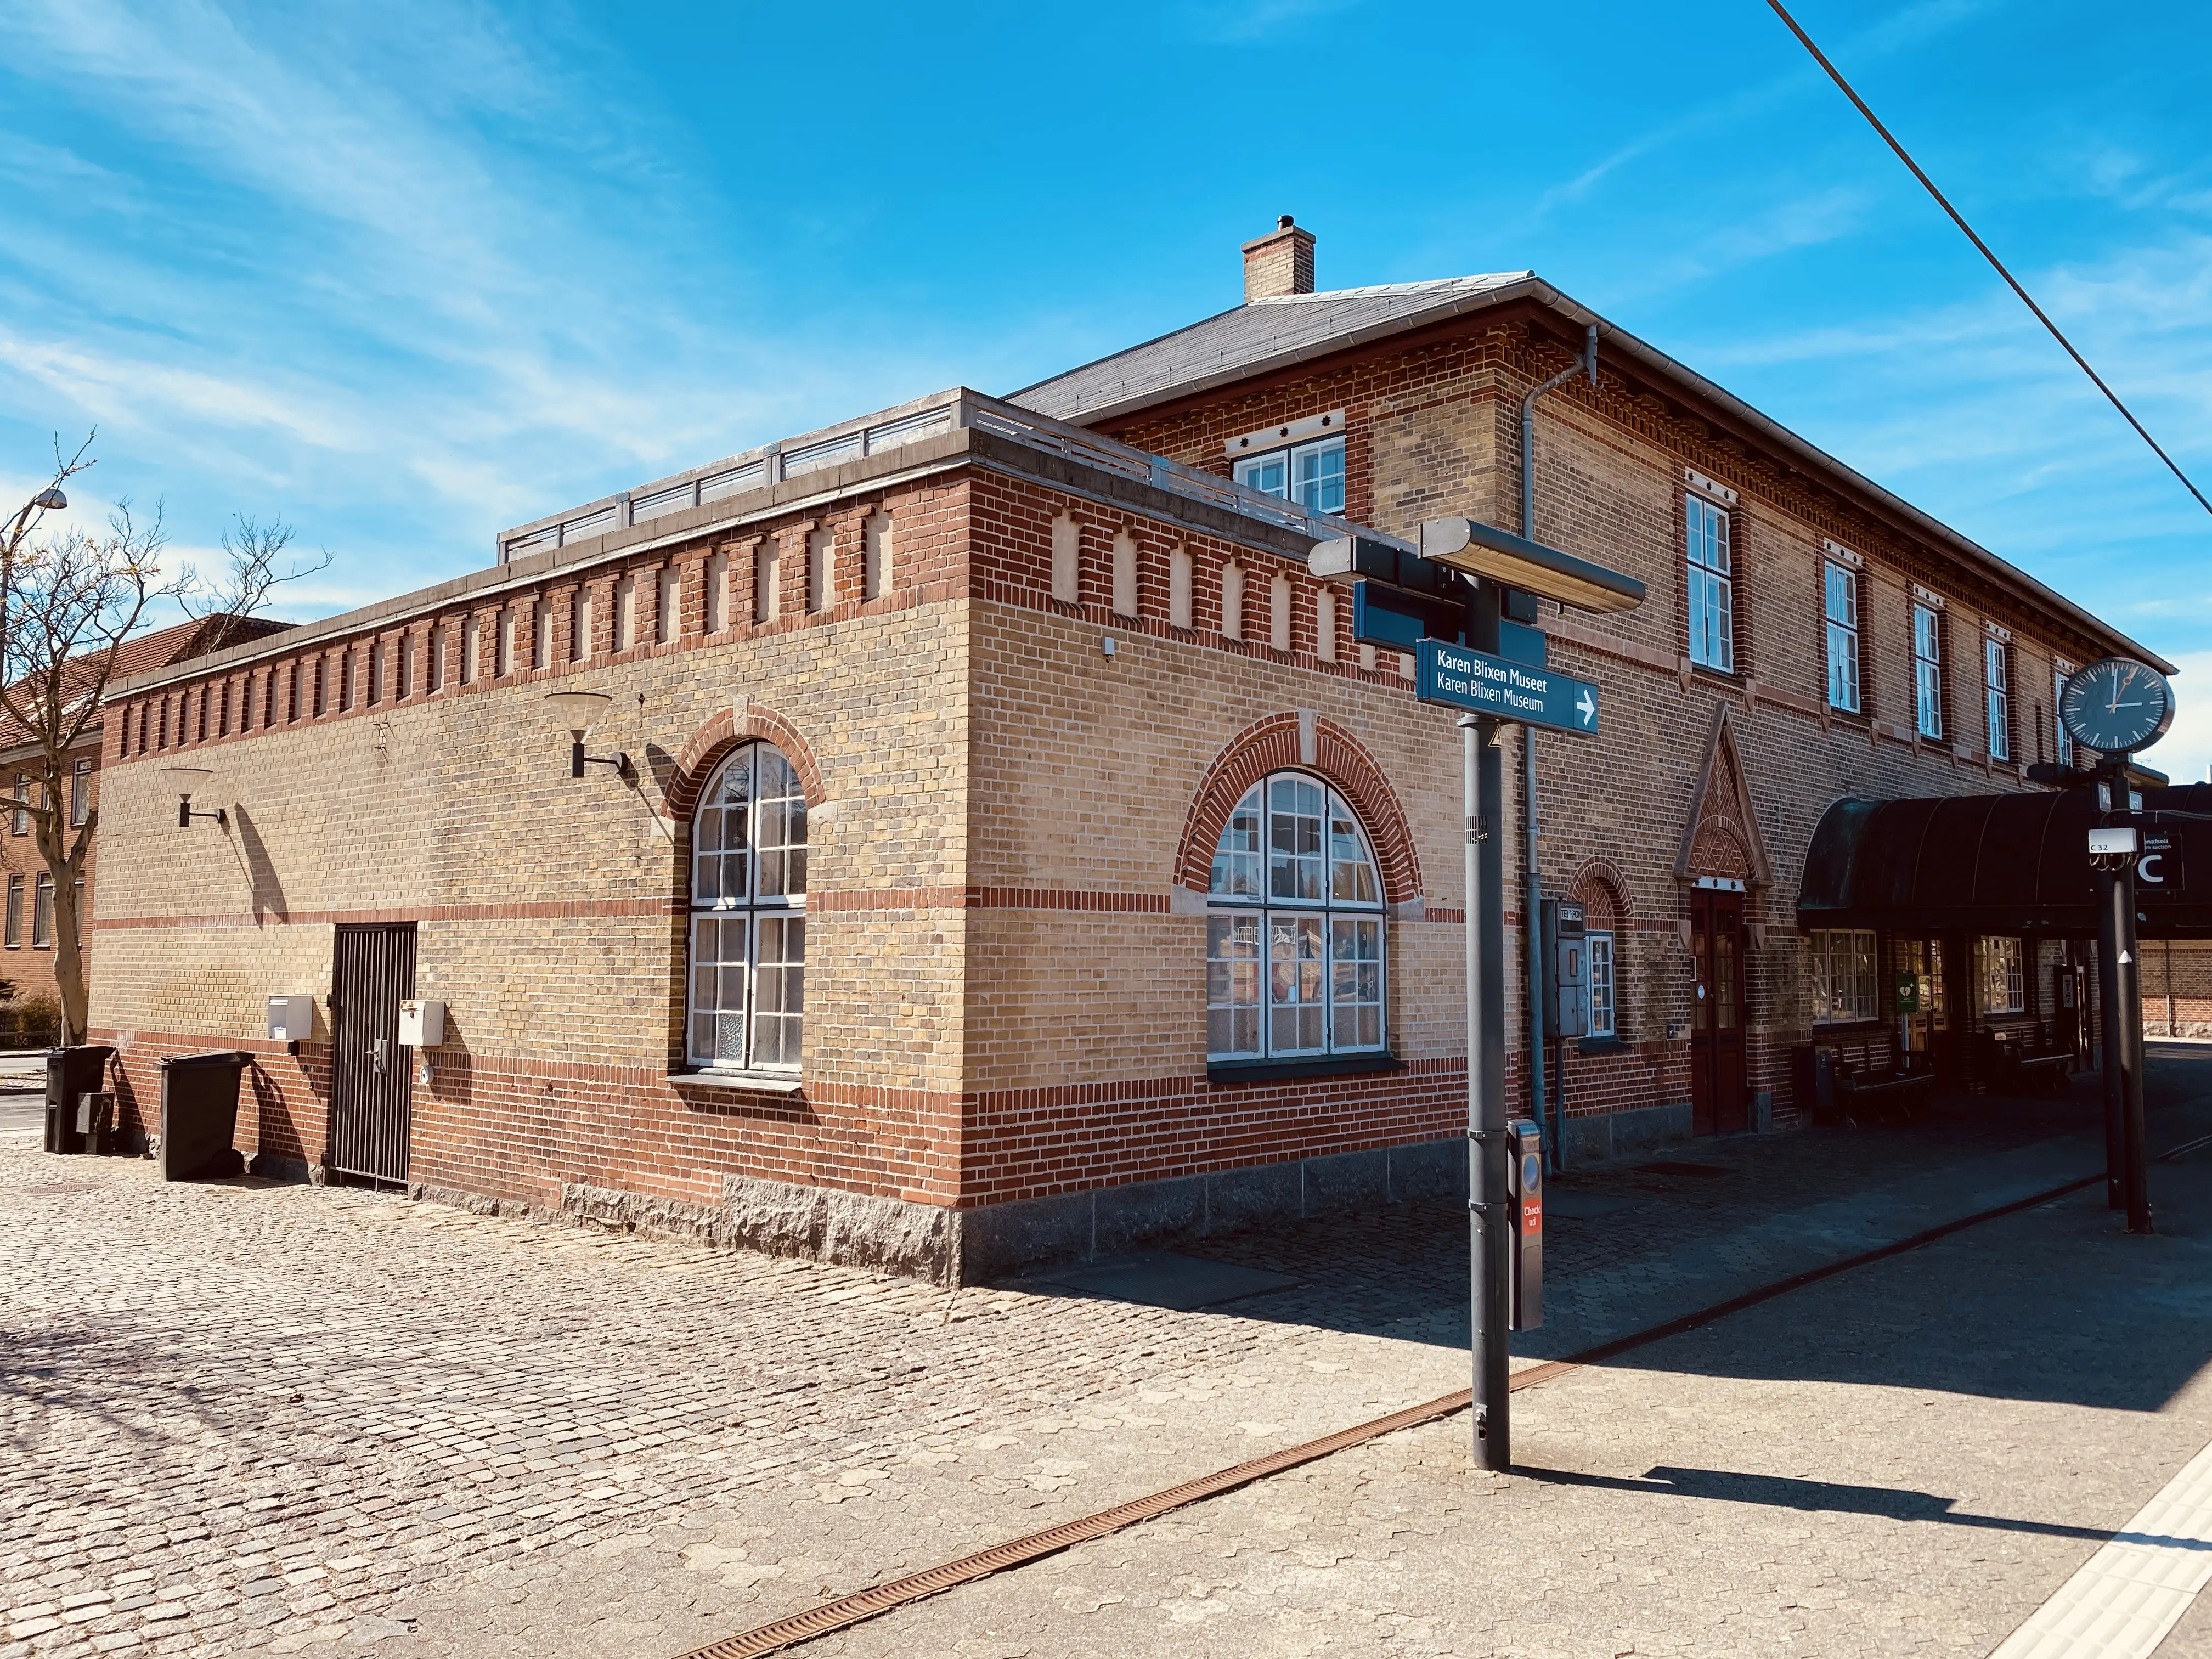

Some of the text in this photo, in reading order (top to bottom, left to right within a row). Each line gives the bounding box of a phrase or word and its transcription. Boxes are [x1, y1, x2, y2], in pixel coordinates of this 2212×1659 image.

[1438, 649, 1547, 693] Karen Blixen Museet
[1437, 672, 1543, 713] Karen Blixen Museum
[2138, 855, 2163, 882] C
[1524, 1205, 1541, 1216] Check
[1529, 1217, 1536, 1226] ud
